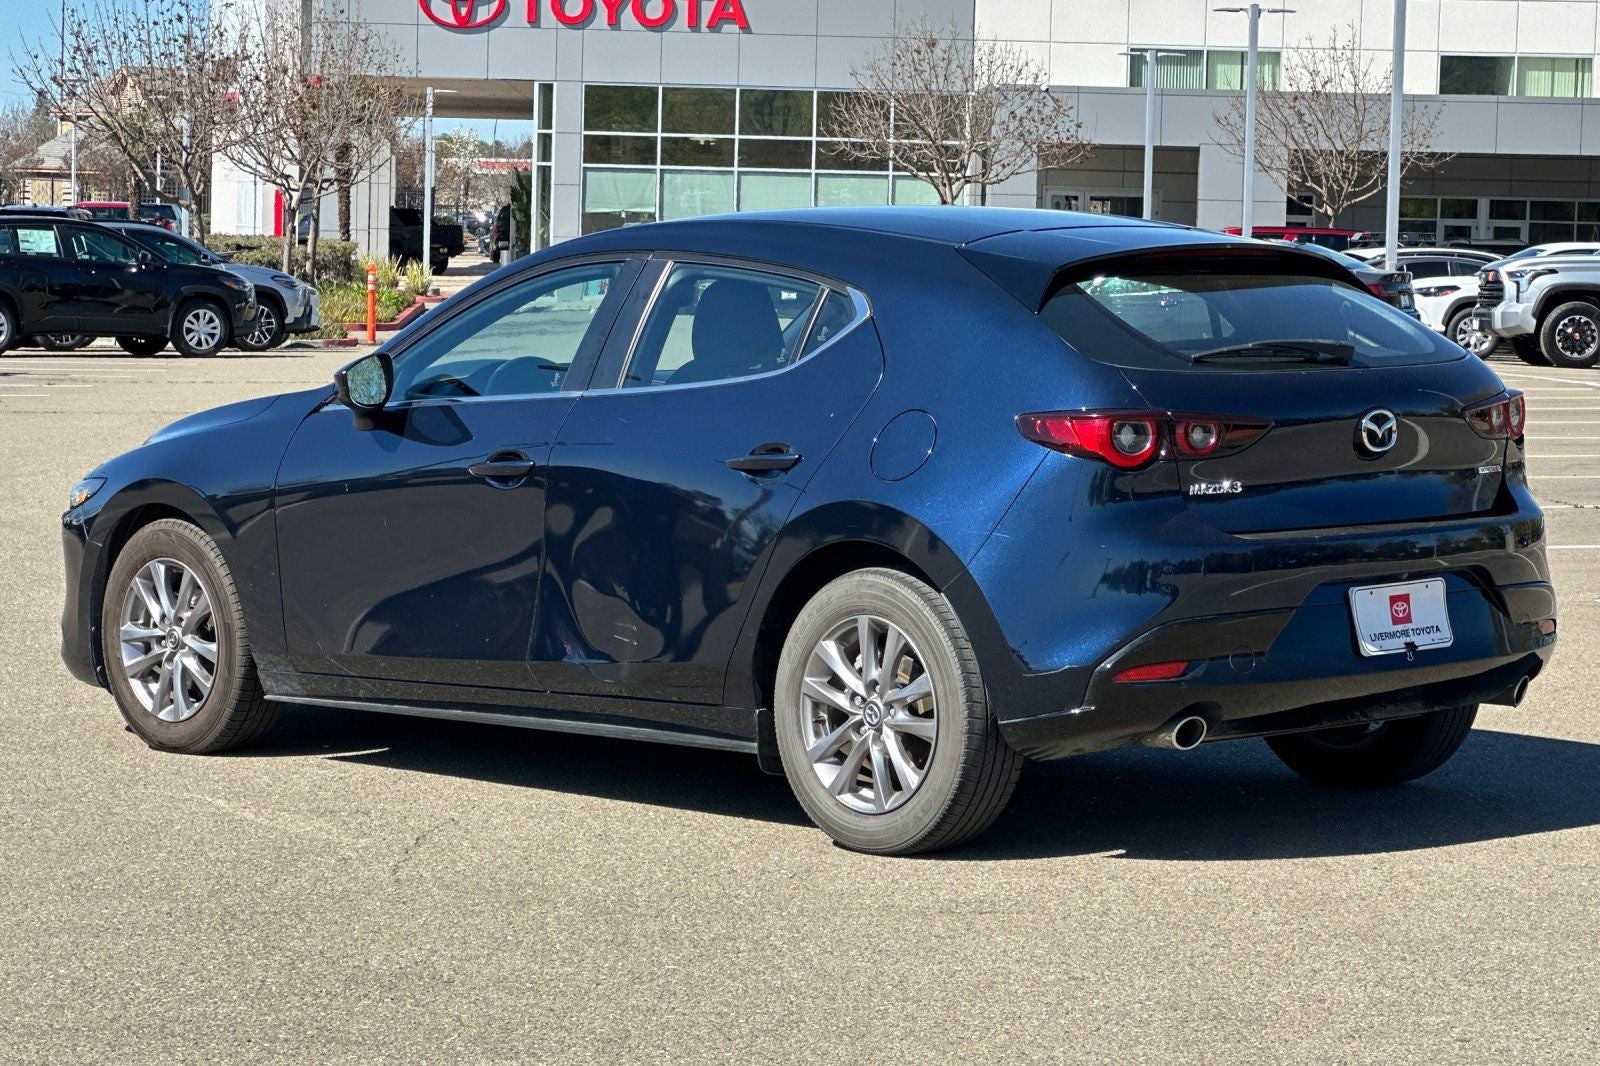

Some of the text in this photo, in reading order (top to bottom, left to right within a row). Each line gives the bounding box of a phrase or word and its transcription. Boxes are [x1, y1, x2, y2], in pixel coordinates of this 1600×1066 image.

[1189, 480, 1242, 495] MAZDA3
[1369, 625, 1441, 642] LIVERMORE TOYOTA
